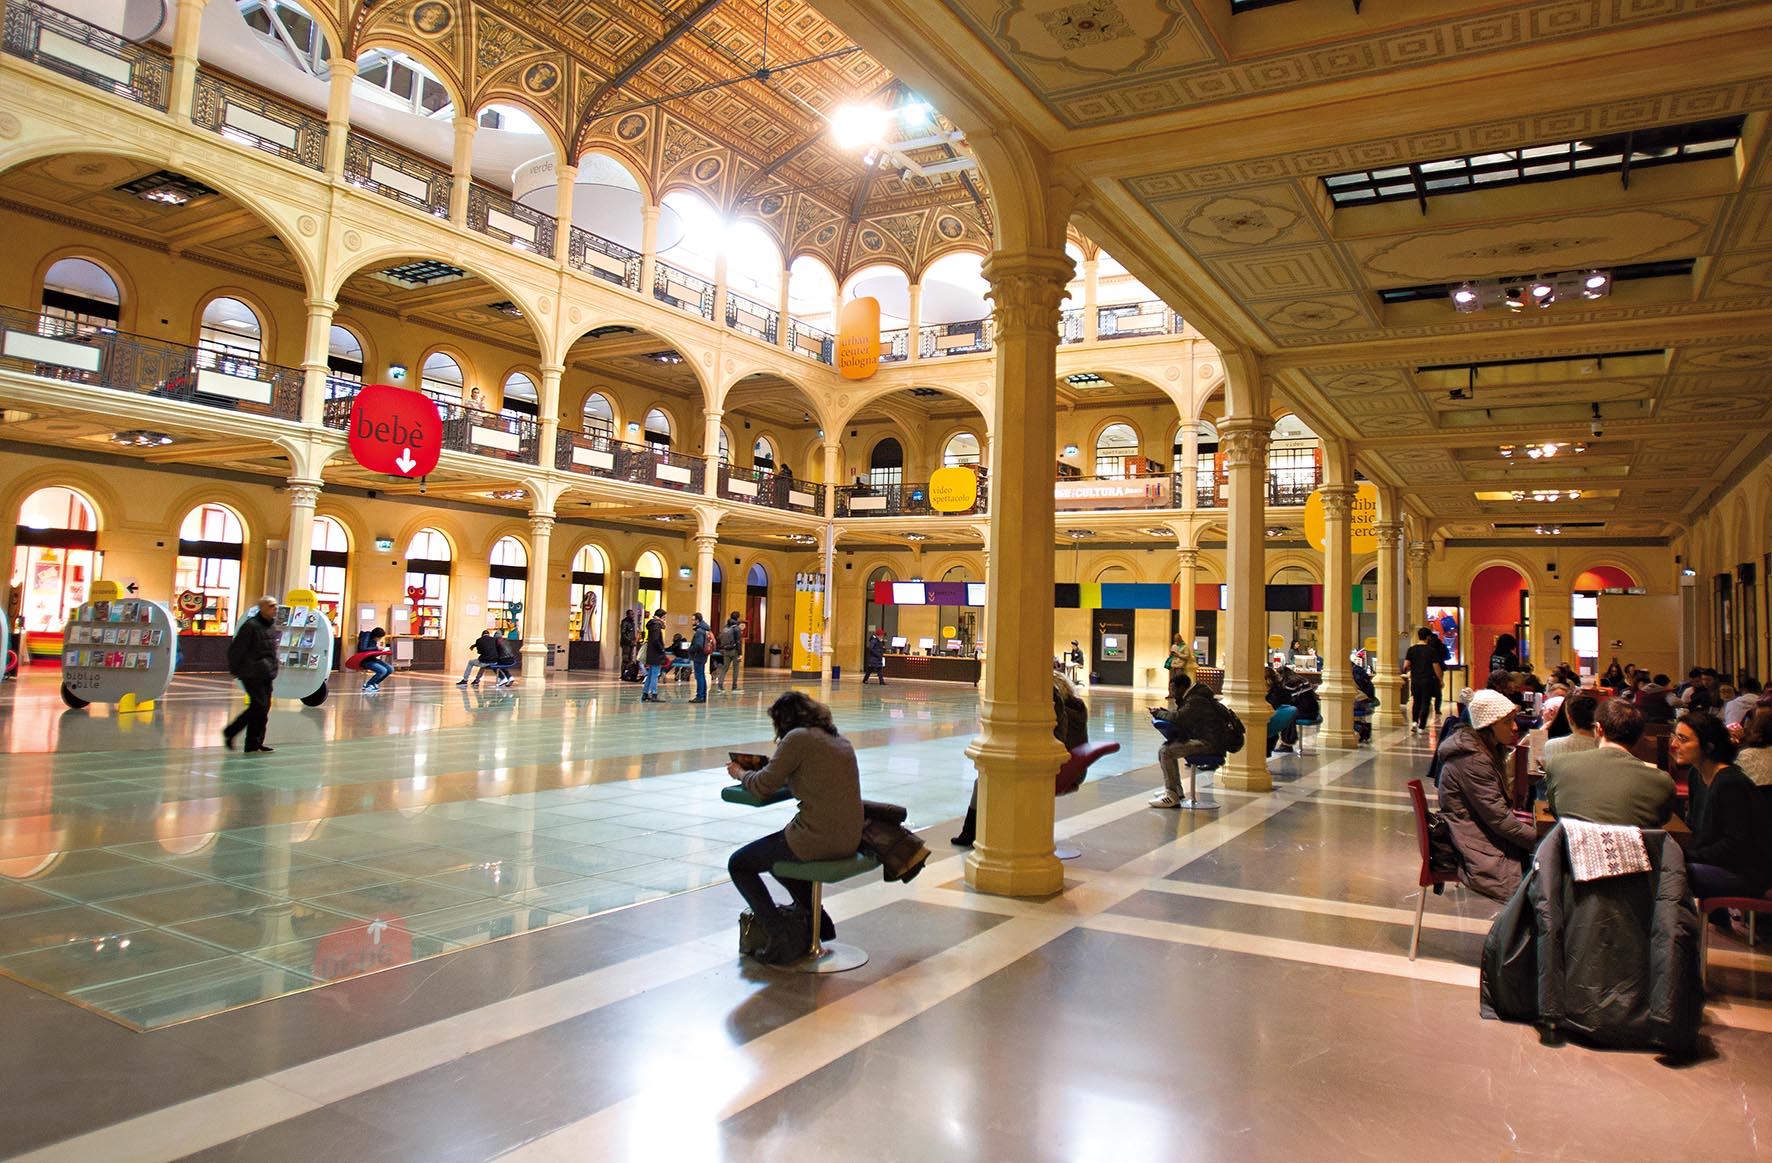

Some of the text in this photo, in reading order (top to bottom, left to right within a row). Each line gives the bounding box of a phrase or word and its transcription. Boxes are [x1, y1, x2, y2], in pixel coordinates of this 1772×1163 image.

[530, 161, 553, 175] verde
[842, 336, 869, 346] urban
[841, 347, 869, 357] center
[841, 357, 877, 368] bologna
[357, 407, 424, 448] bebè
[932, 486, 953, 494] video
[932, 494, 970, 504] spettacolo
[66, 671, 101, 681] biblio
